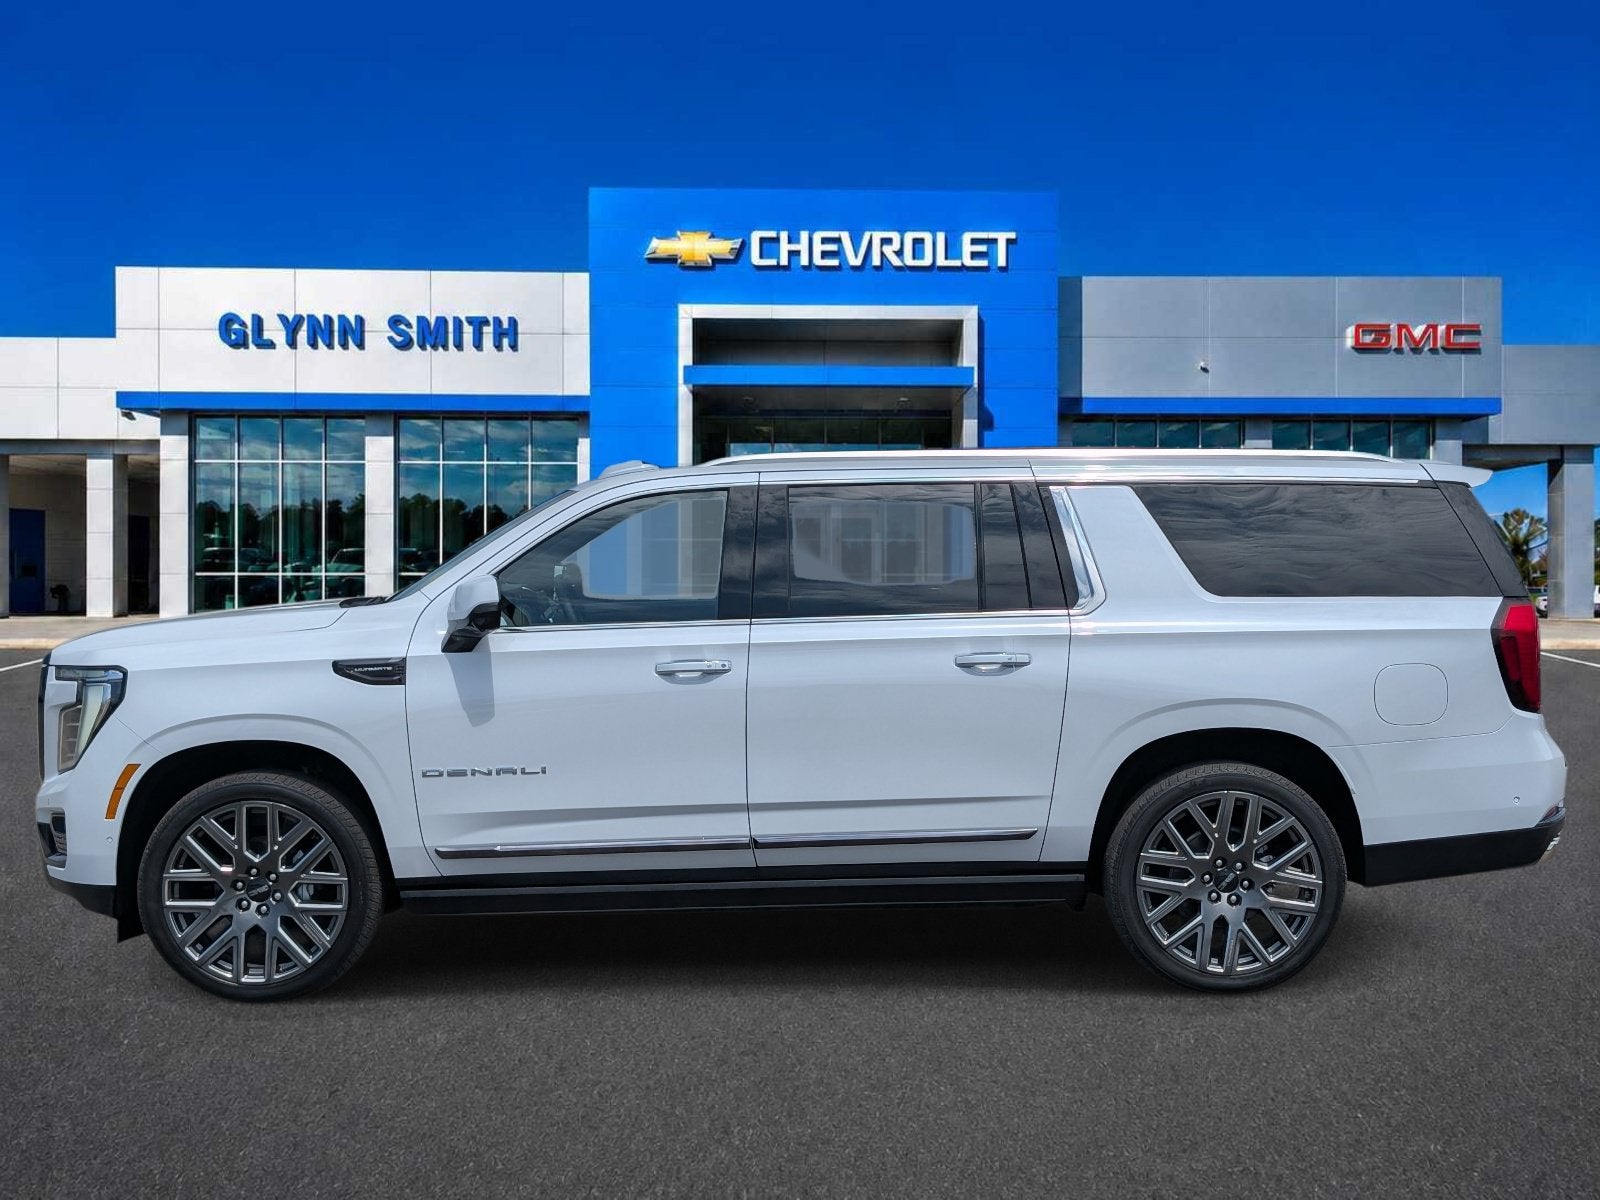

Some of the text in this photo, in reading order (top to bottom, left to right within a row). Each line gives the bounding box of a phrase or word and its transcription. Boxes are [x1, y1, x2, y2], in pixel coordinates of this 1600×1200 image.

[750, 230, 1017, 269] CHEVROLET
[218, 312, 519, 352] GLYNN SMITH
[1347, 323, 1482, 352] GMC
[421, 765, 547, 778] DENALI
